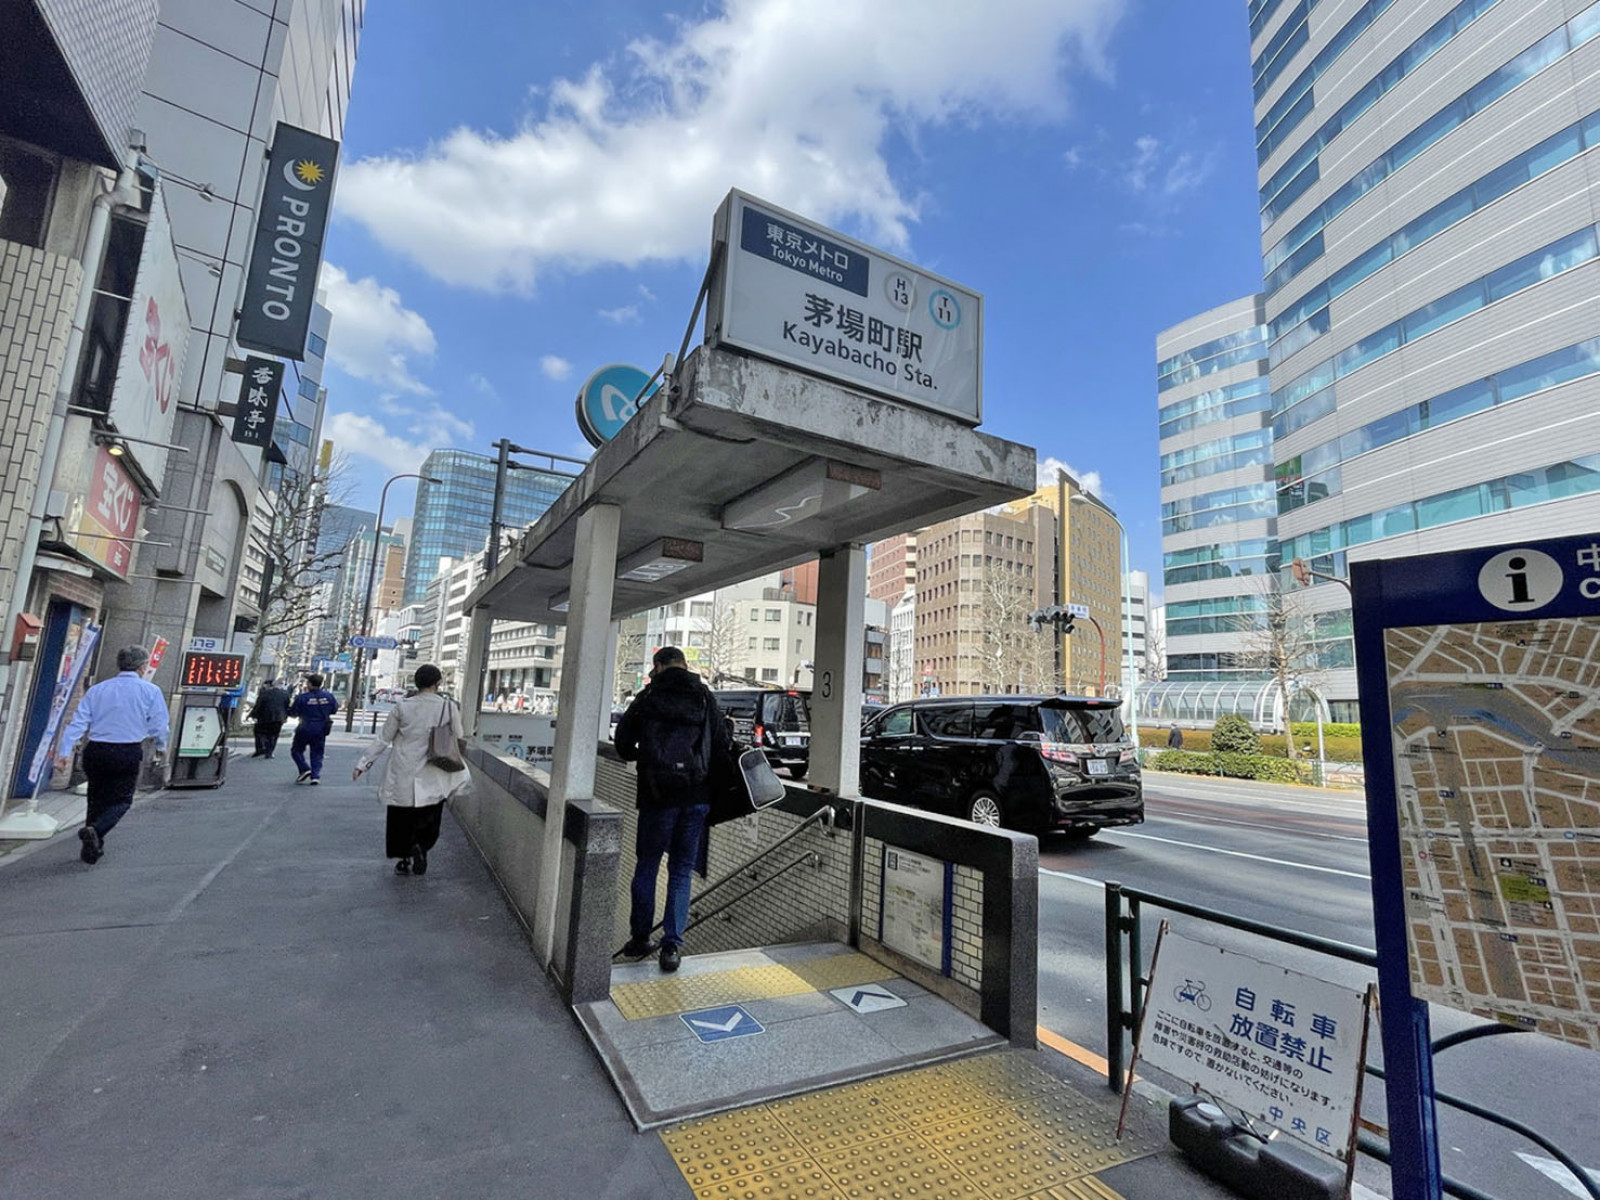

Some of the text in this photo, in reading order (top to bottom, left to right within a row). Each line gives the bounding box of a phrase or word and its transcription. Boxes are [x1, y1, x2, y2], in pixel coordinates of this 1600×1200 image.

[263, 195, 310, 321] PRONTO
[766, 221, 849, 271] 東京メトロ
[770, 243, 844, 284] Tokyo Metro
[893, 289, 909, 306] 13
[896, 277, 906, 290] H
[941, 297, 950, 308] T
[803, 292, 923, 363] 茅場町駅
[937, 306, 951, 323] 11
[783, 320, 938, 390] Kayabacho Sta.
[244, 366, 273, 429] 香味亭
[98, 462, 134, 533] 宝くじ
[822, 671, 831, 698] 3
[1235, 987, 1337, 1040] 自転車
[1229, 1013, 1333, 1074] 放置禁止
[1268, 1105, 1333, 1147] 中央区
